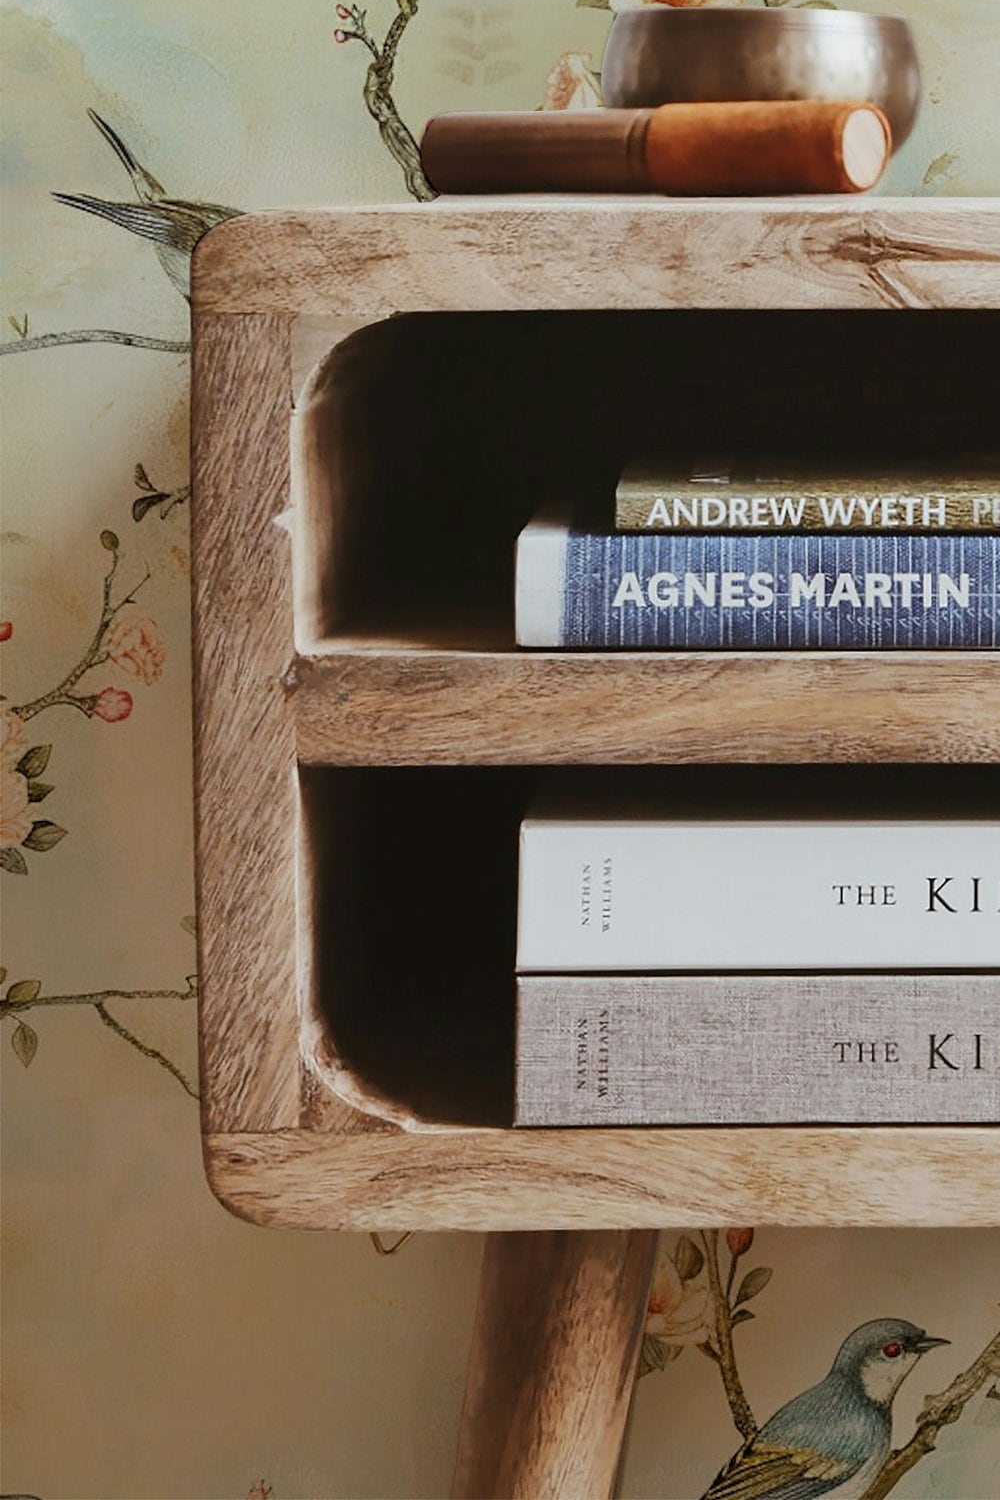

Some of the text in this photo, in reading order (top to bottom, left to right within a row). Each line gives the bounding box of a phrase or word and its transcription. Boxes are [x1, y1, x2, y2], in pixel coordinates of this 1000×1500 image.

[646, 496, 807, 527] ANDREW
[818, 496, 946, 527] WYETH
[612, 571, 971, 610] AGNES MARTIN
[580, 863, 592, 927] NATHAN
[601, 857, 613, 934] WILLIAMS
[831, 884, 898, 907] THE
[576, 1016, 588, 1091] NATHAN
[597, 1008, 609, 1099] WILLIAMS
[831, 1040, 900, 1064] THE
